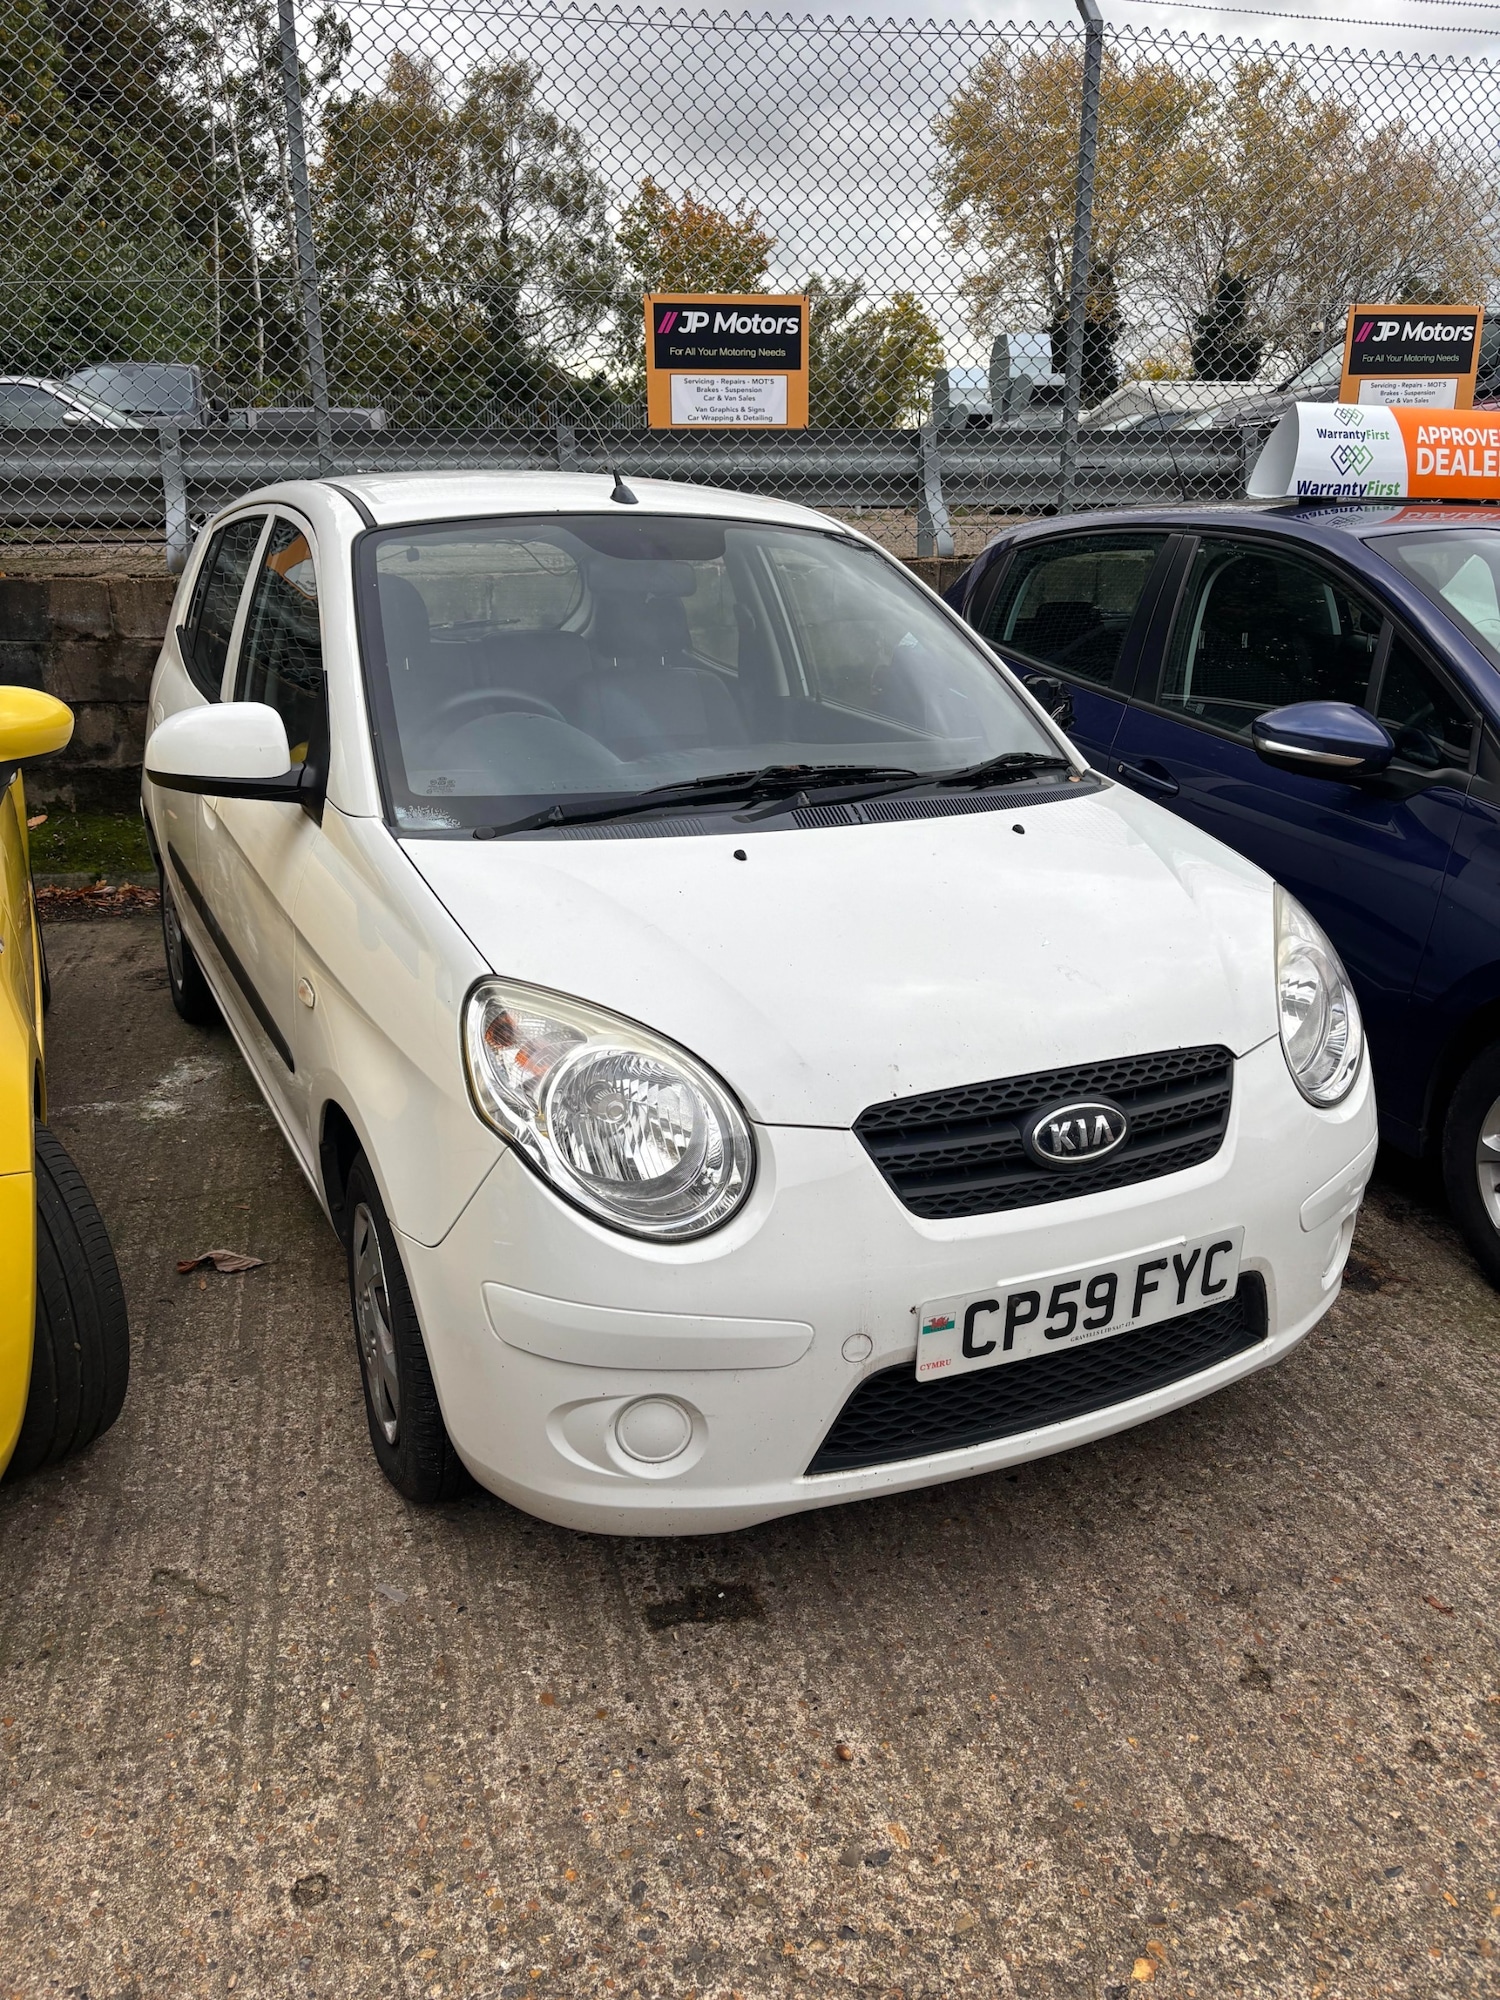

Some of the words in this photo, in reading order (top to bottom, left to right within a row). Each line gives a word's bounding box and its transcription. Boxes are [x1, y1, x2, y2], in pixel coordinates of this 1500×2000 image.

[678, 311, 709, 333] JP
[713, 312, 799, 335] Motors
[1372, 321, 1400, 342] JP
[1401, 321, 1474, 342] Motors
[669, 347, 684, 356] For
[685, 347, 696, 356] All
[698, 347, 718, 356] Your
[719, 347, 757, 358] Motoring
[758, 348, 786, 357] Needs
[1362, 354, 1375, 362] For
[1375, 354, 1384, 362] All
[1385, 354, 1402, 362] Your
[1404, 354, 1435, 363] Motoring
[1436, 354, 1460, 362] Needs
[683, 378, 715, 386] Servicing
[720, 378, 746, 386] Repairs
[725, 386, 763, 394] Suspension
[709, 406, 739, 414] Graphics
[747, 406, 766, 414] Signs
[700, 414, 734, 422] Wrapping
[743, 414, 773, 422] Detailing
[1316, 428, 1390, 443] WarrantyFirst
[1416, 425, 1500, 447] APPROVE
[1416, 447, 1500, 477] DEALE
[1297, 480, 1401, 498] WarrantyFirst
[1048, 1114, 1115, 1153] KIA
[961, 1272, 1118, 1359] CP59
[1131, 1240, 1233, 1319] FYC
[919, 1358, 952, 1371] CYMRU
